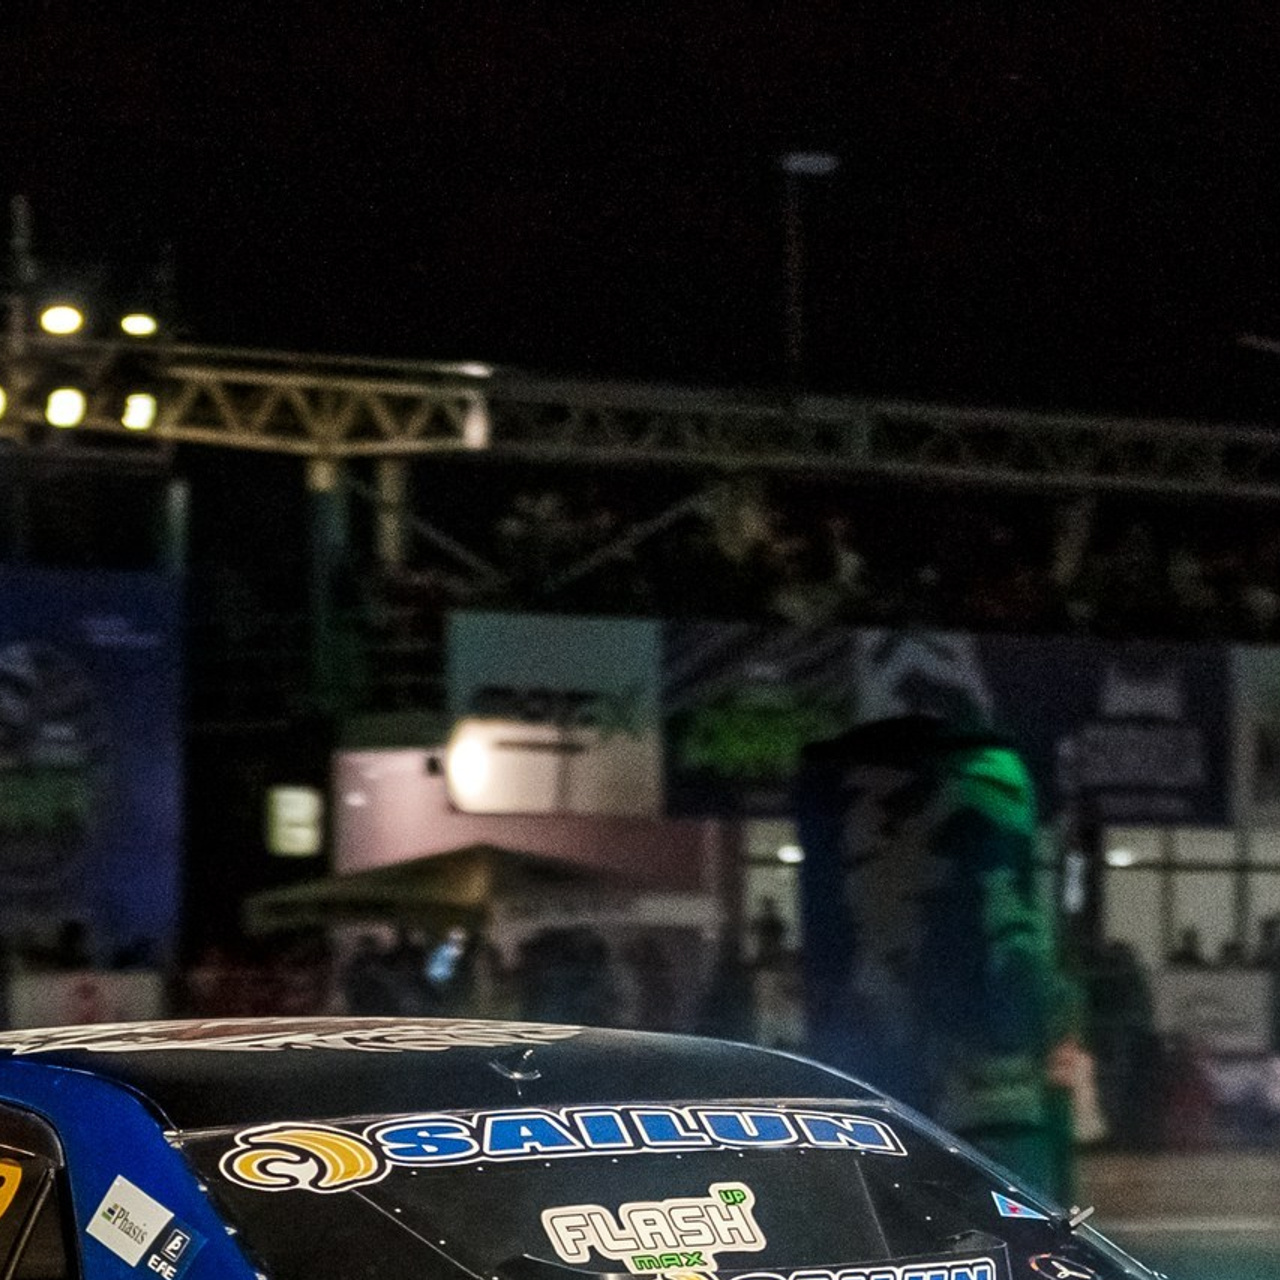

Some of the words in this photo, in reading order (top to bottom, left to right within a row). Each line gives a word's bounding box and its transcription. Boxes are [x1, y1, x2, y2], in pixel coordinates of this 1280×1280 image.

[372, 1107, 902, 1164] SAILUN
[718, 1189, 748, 1206] UP
[110, 1206, 149, 1246] Phasis
[549, 1203, 758, 1257] FLASH
